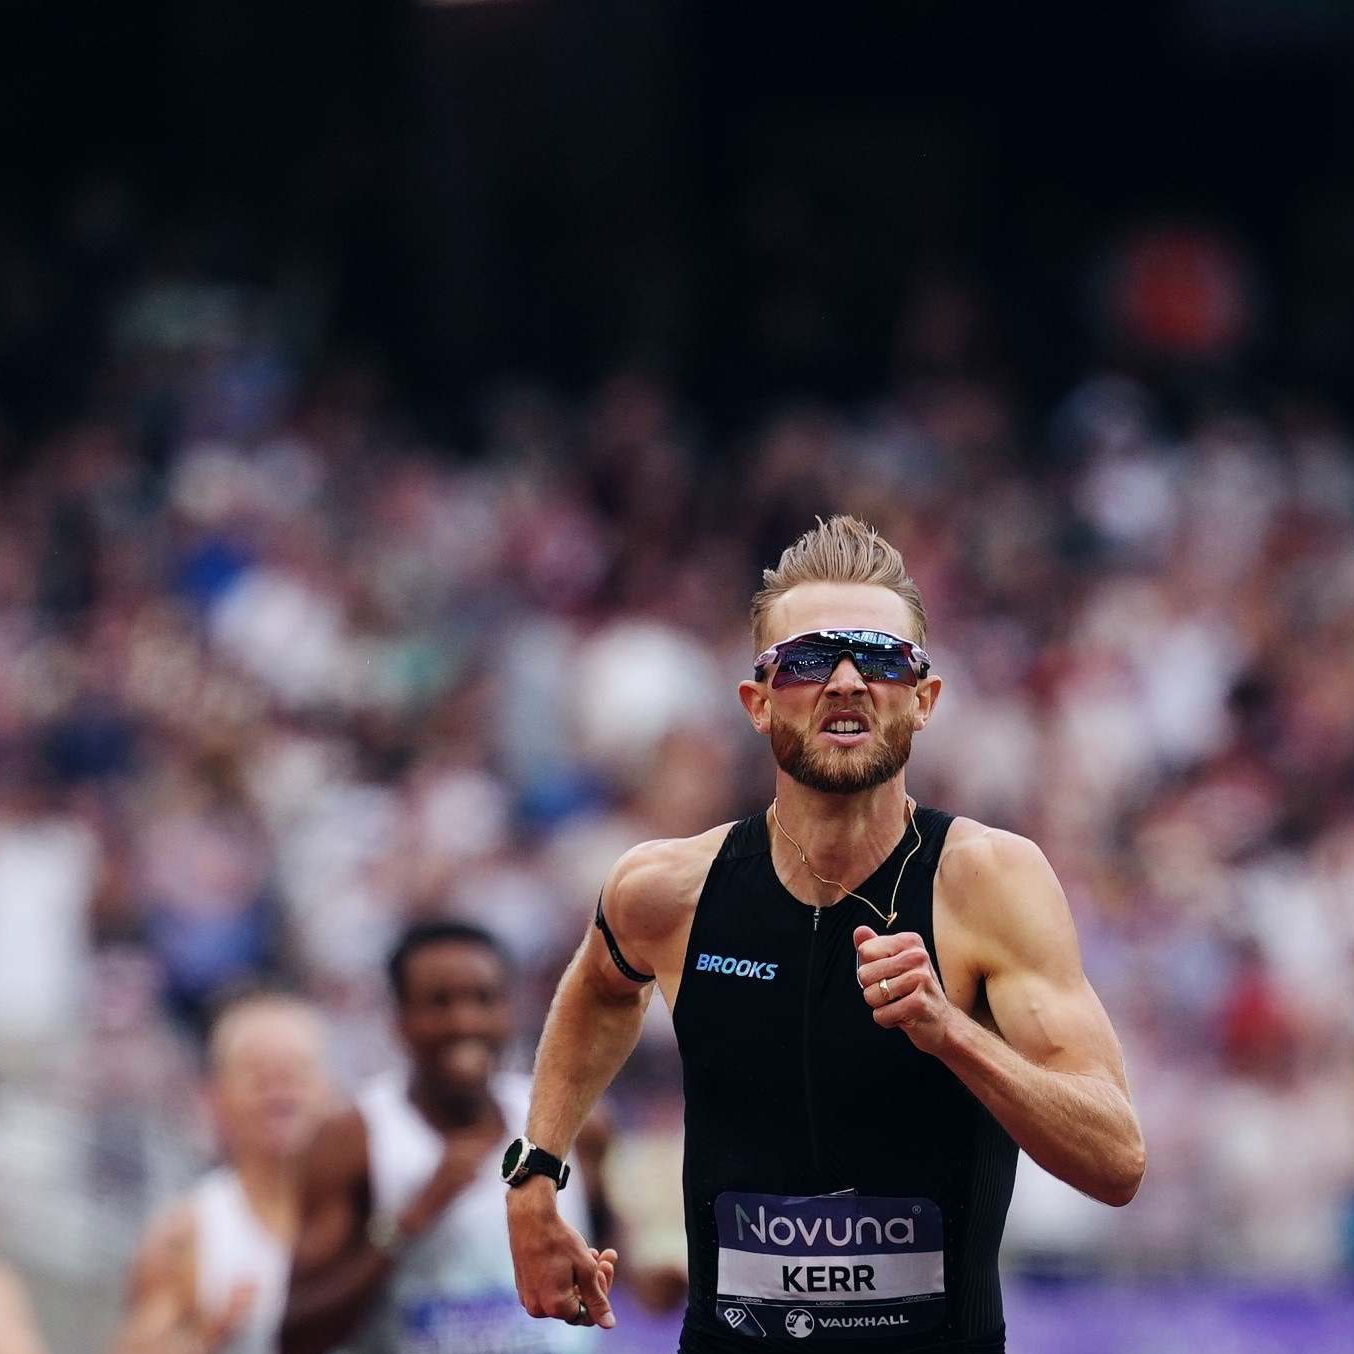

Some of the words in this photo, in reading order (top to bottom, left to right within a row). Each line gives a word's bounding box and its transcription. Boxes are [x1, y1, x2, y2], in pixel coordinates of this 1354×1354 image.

[695, 953, 779, 981] BROOKS
[782, 1264, 877, 1293] KERR
[736, 1296, 763, 1304] LONDON
[818, 1314, 909, 1329] VAUXHALL
